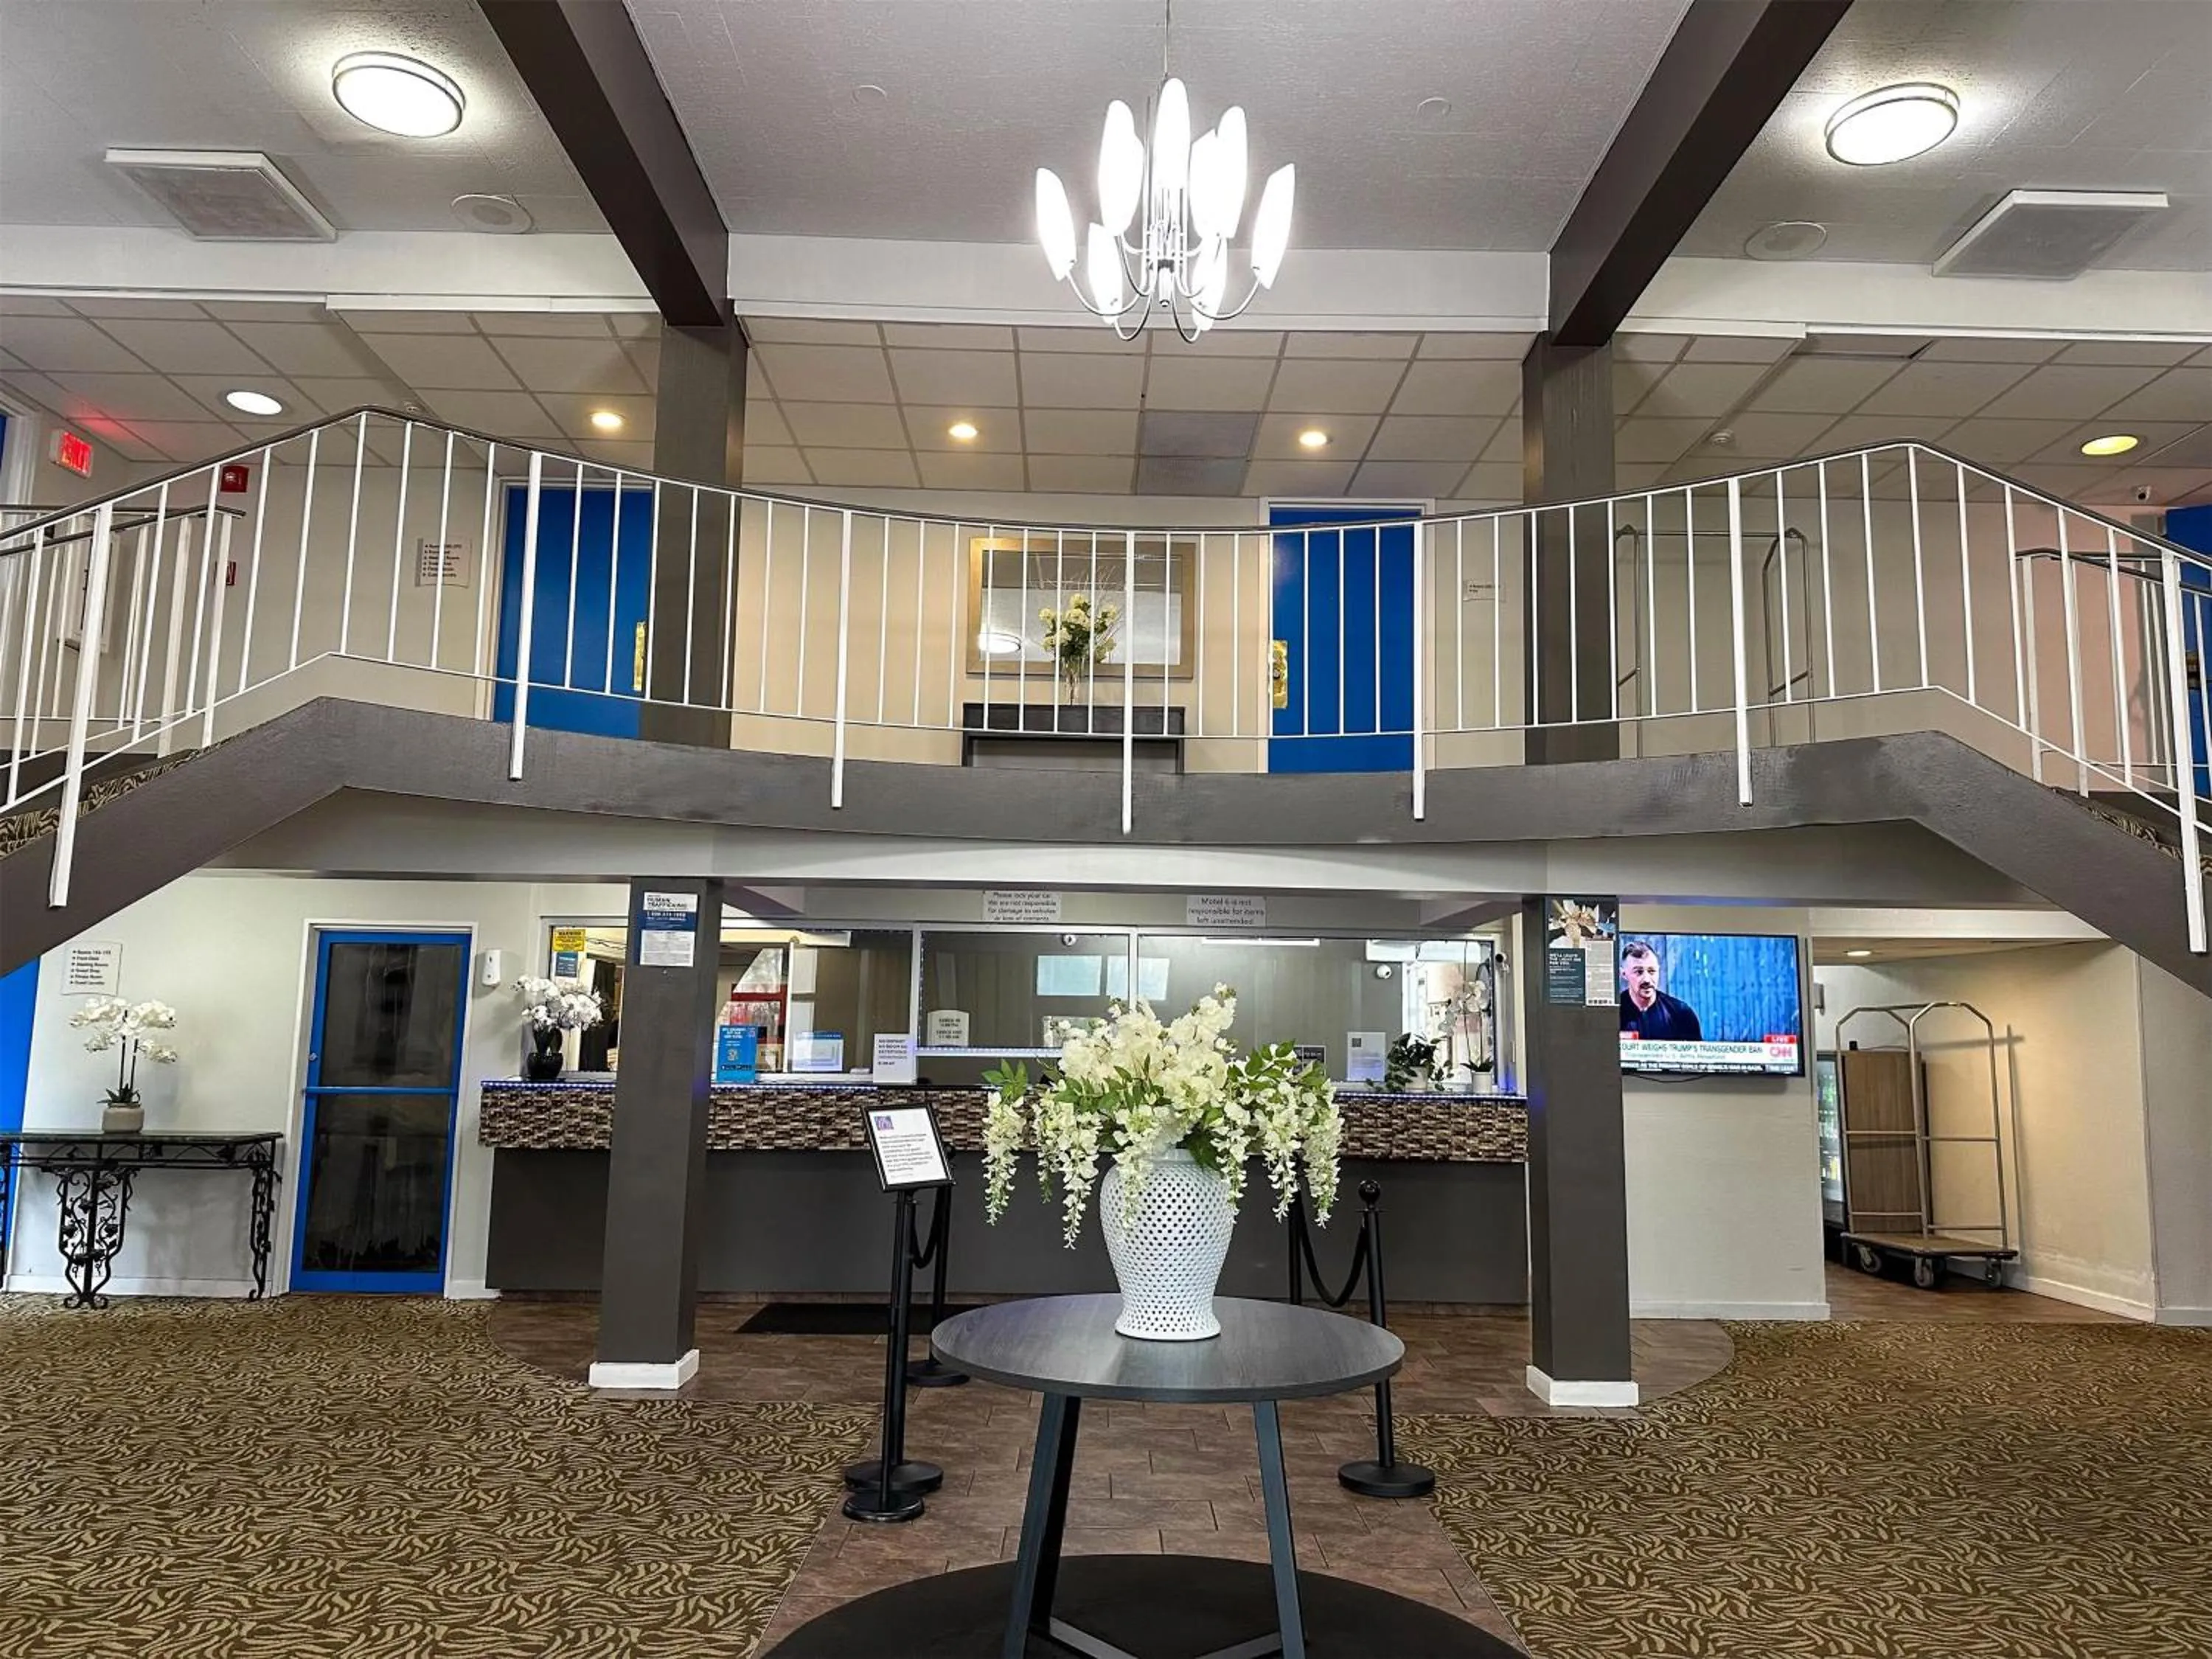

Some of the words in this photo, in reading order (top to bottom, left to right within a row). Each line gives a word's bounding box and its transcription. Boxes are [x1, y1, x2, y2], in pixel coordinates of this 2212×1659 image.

[1201, 897, 1222, 905] Motel
[1771, 1035, 1789, 1043] LIVE
[1642, 1043, 1667, 1051] WEIGHS
[1669, 1043, 1698, 1053] TRUMP'S
[1700, 1044, 1747, 1053] TRANSGENDER
[1749, 1046, 1763, 1054] BAN
[1770, 1046, 1792, 1057] CNN
